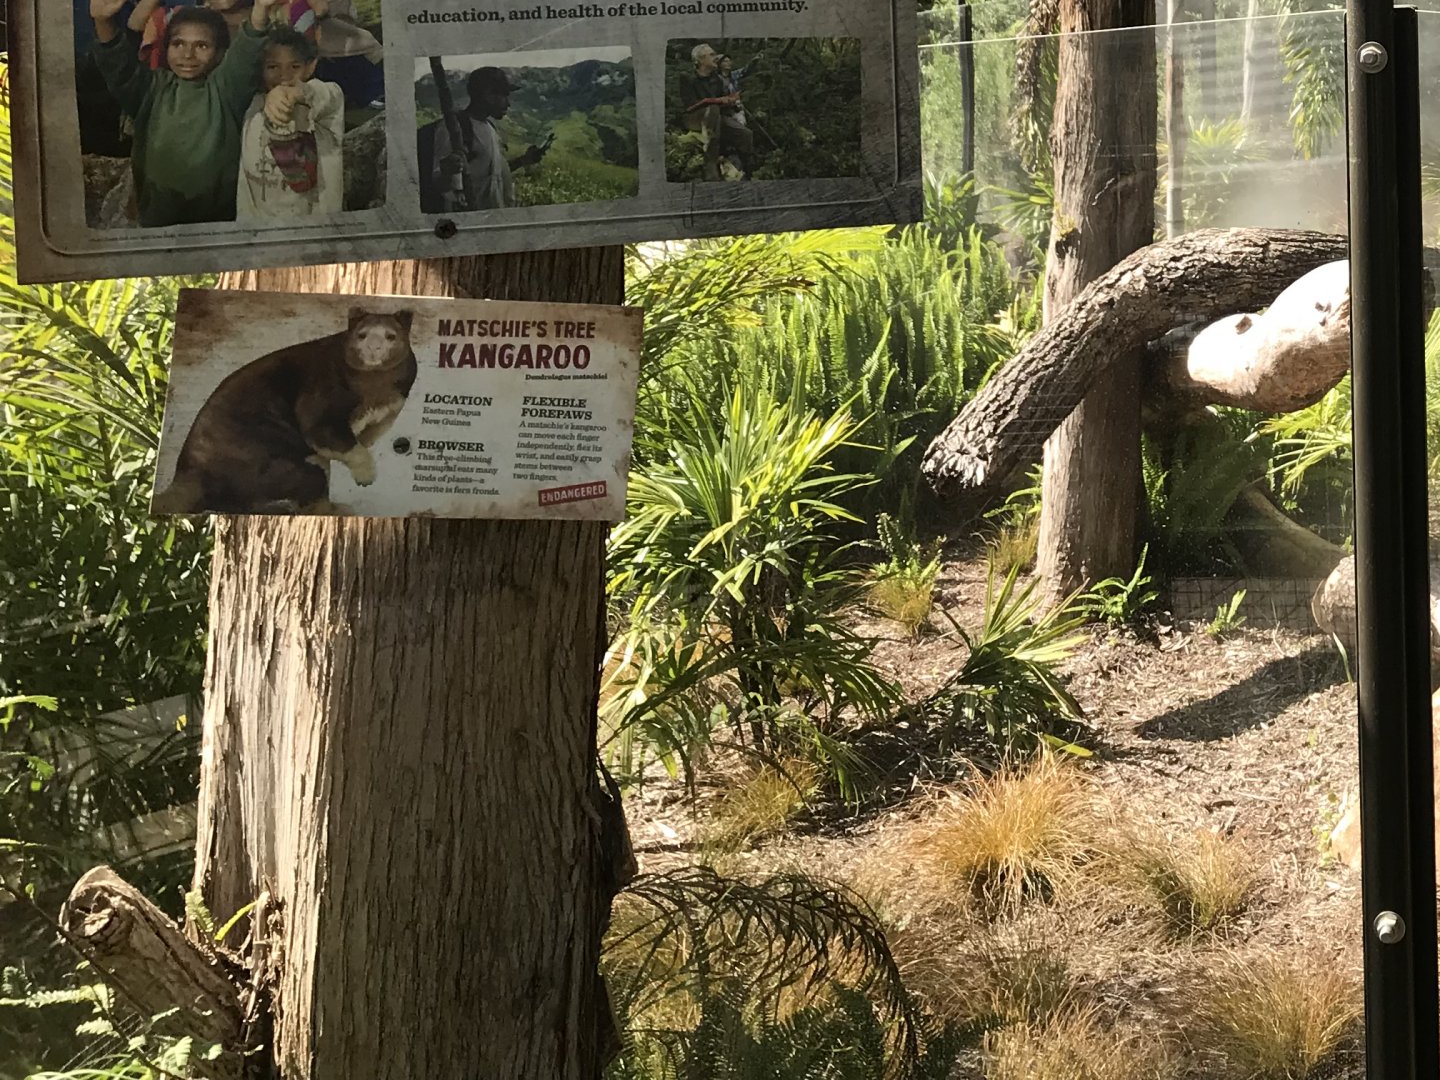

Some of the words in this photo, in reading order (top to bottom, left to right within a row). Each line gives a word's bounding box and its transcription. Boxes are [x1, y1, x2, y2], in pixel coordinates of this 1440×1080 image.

[407, 7, 505, 24] education,
[508, 6, 542, 20] and
[546, 4, 605, 19] health
[608, 3, 626, 17] of
[629, 3, 658, 15] the
[661, 1, 703, 15] local
[438, 320, 548, 339] MATSCHIE'S
[554, 321, 595, 339] TREE
[438, 343, 591, 369] KANGAROO
[424, 394, 493, 406] LOCATION
[523, 396, 587, 408] FLEXIBLE
[423, 407, 454, 415] Eastern
[457, 408, 481, 417] Papua
[521, 408, 592, 420] FOREPAWS
[570, 423, 607, 432] kangaroo
[577, 433, 600, 442] finger
[418, 440, 484, 452] BROWSER
[580, 455, 602, 463] grasp
[540, 462, 572, 471] between
[412, 484, 444, 493] favorite
[541, 483, 605, 503] ENDANGERED
